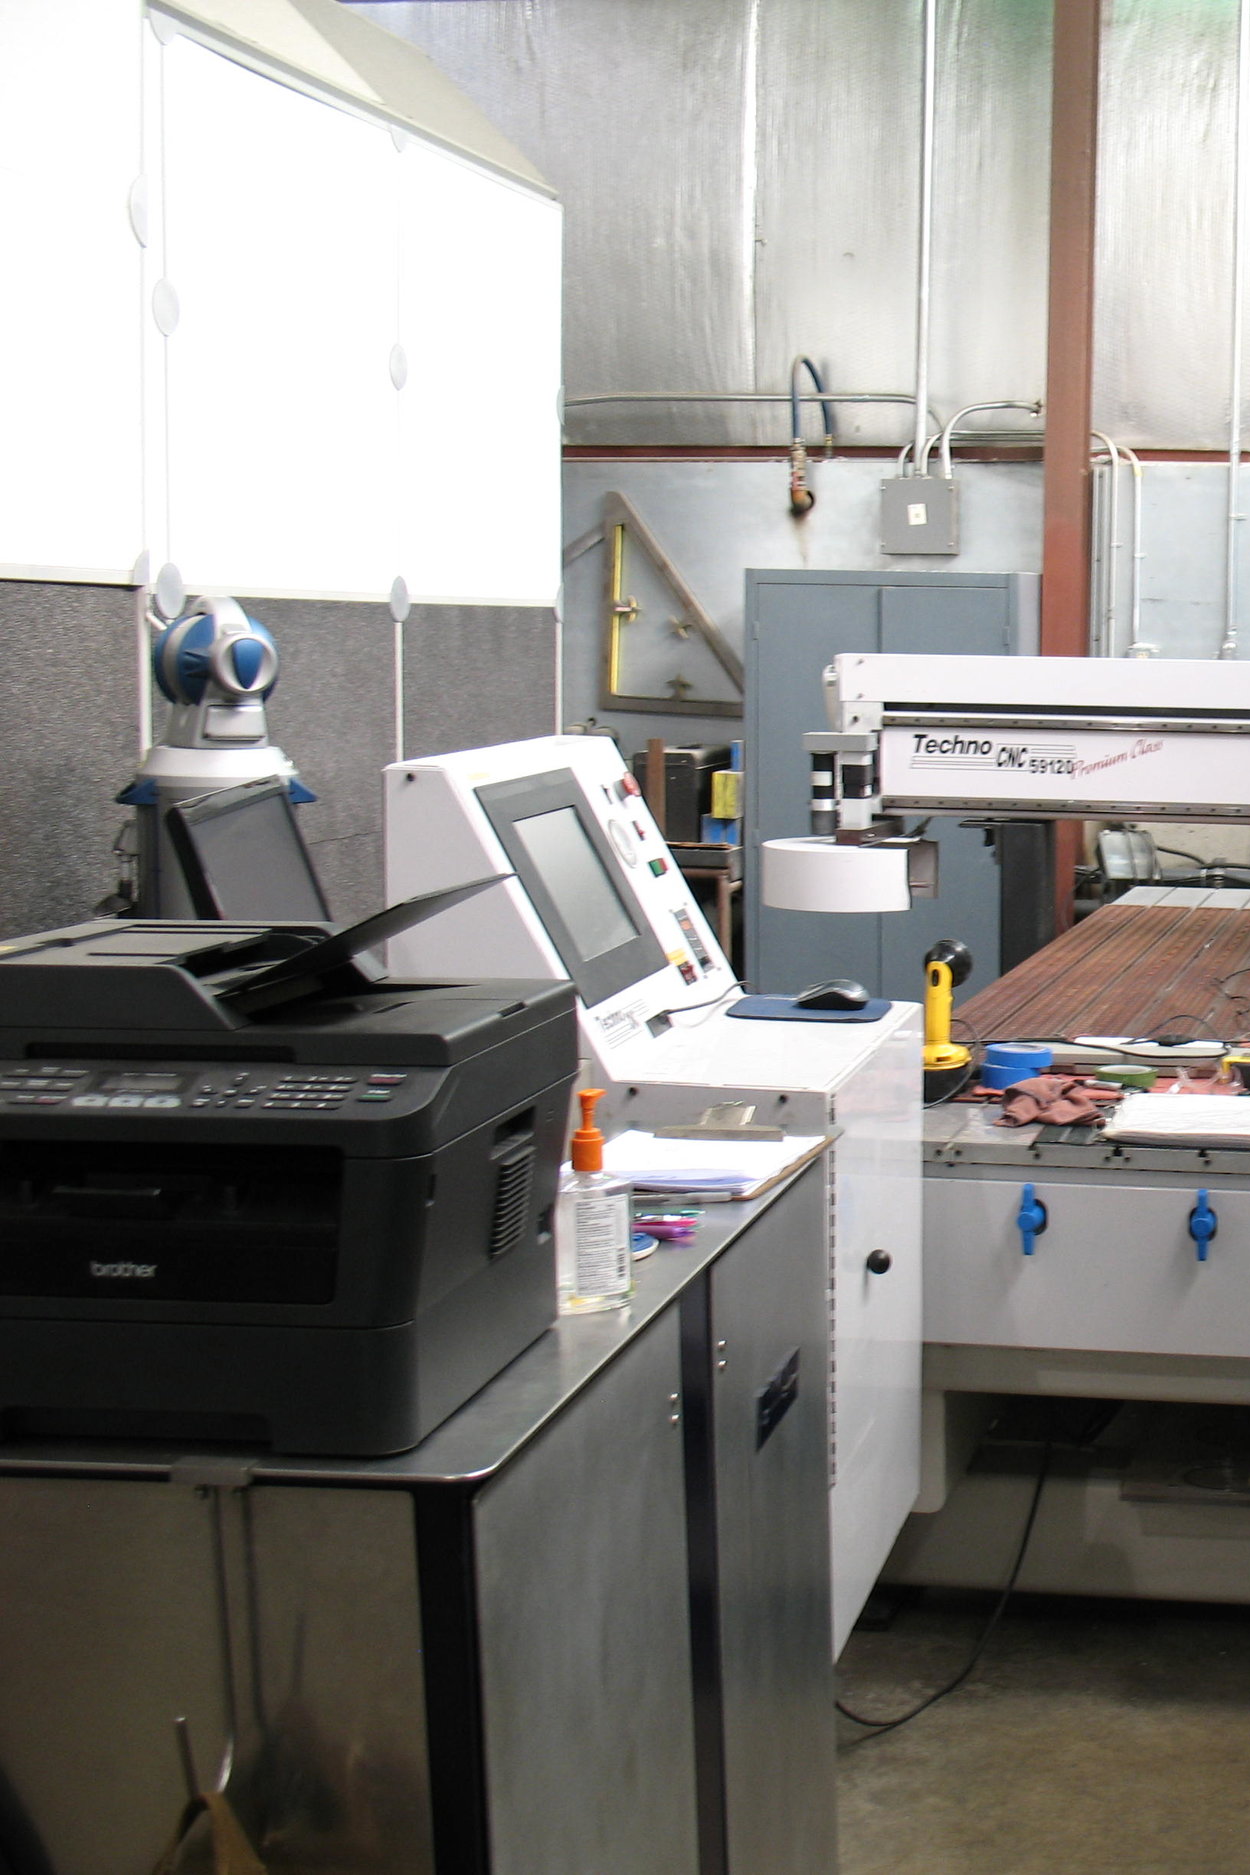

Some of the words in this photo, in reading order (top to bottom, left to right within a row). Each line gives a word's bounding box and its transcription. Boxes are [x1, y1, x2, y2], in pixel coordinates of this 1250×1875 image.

[912, 734, 993, 755] Techno
[996, 747, 1029, 768] CNC
[1029, 759, 1074, 774] 59120
[1070, 753, 1129, 780] Premium
